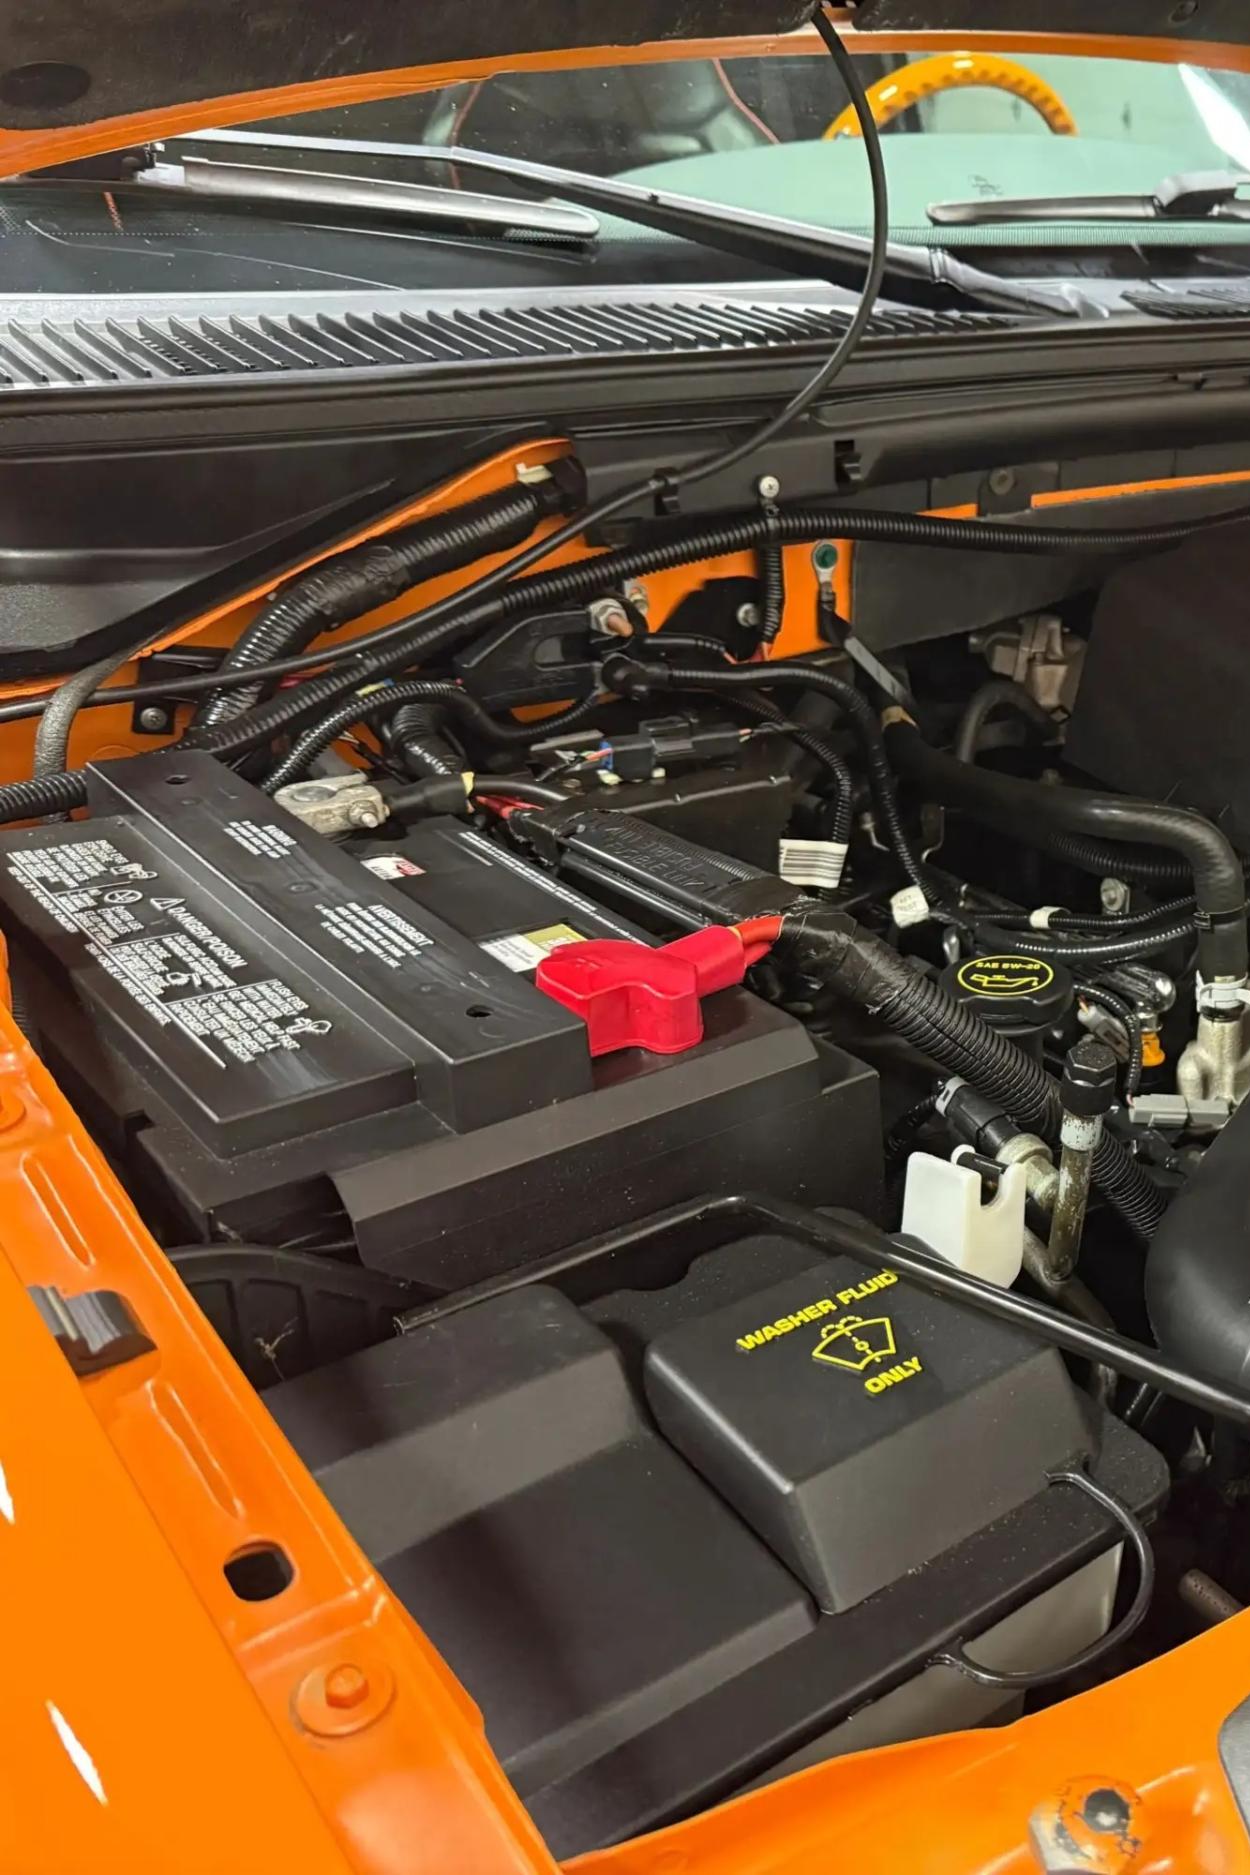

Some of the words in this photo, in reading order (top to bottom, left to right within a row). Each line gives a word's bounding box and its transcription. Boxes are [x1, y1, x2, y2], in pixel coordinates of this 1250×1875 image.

[164, 906, 251, 968] DANGER/POISON
[736, 1299, 837, 1350] WASHER
[836, 1269, 898, 1305] FLUID
[864, 1357, 923, 1394] ONLY
